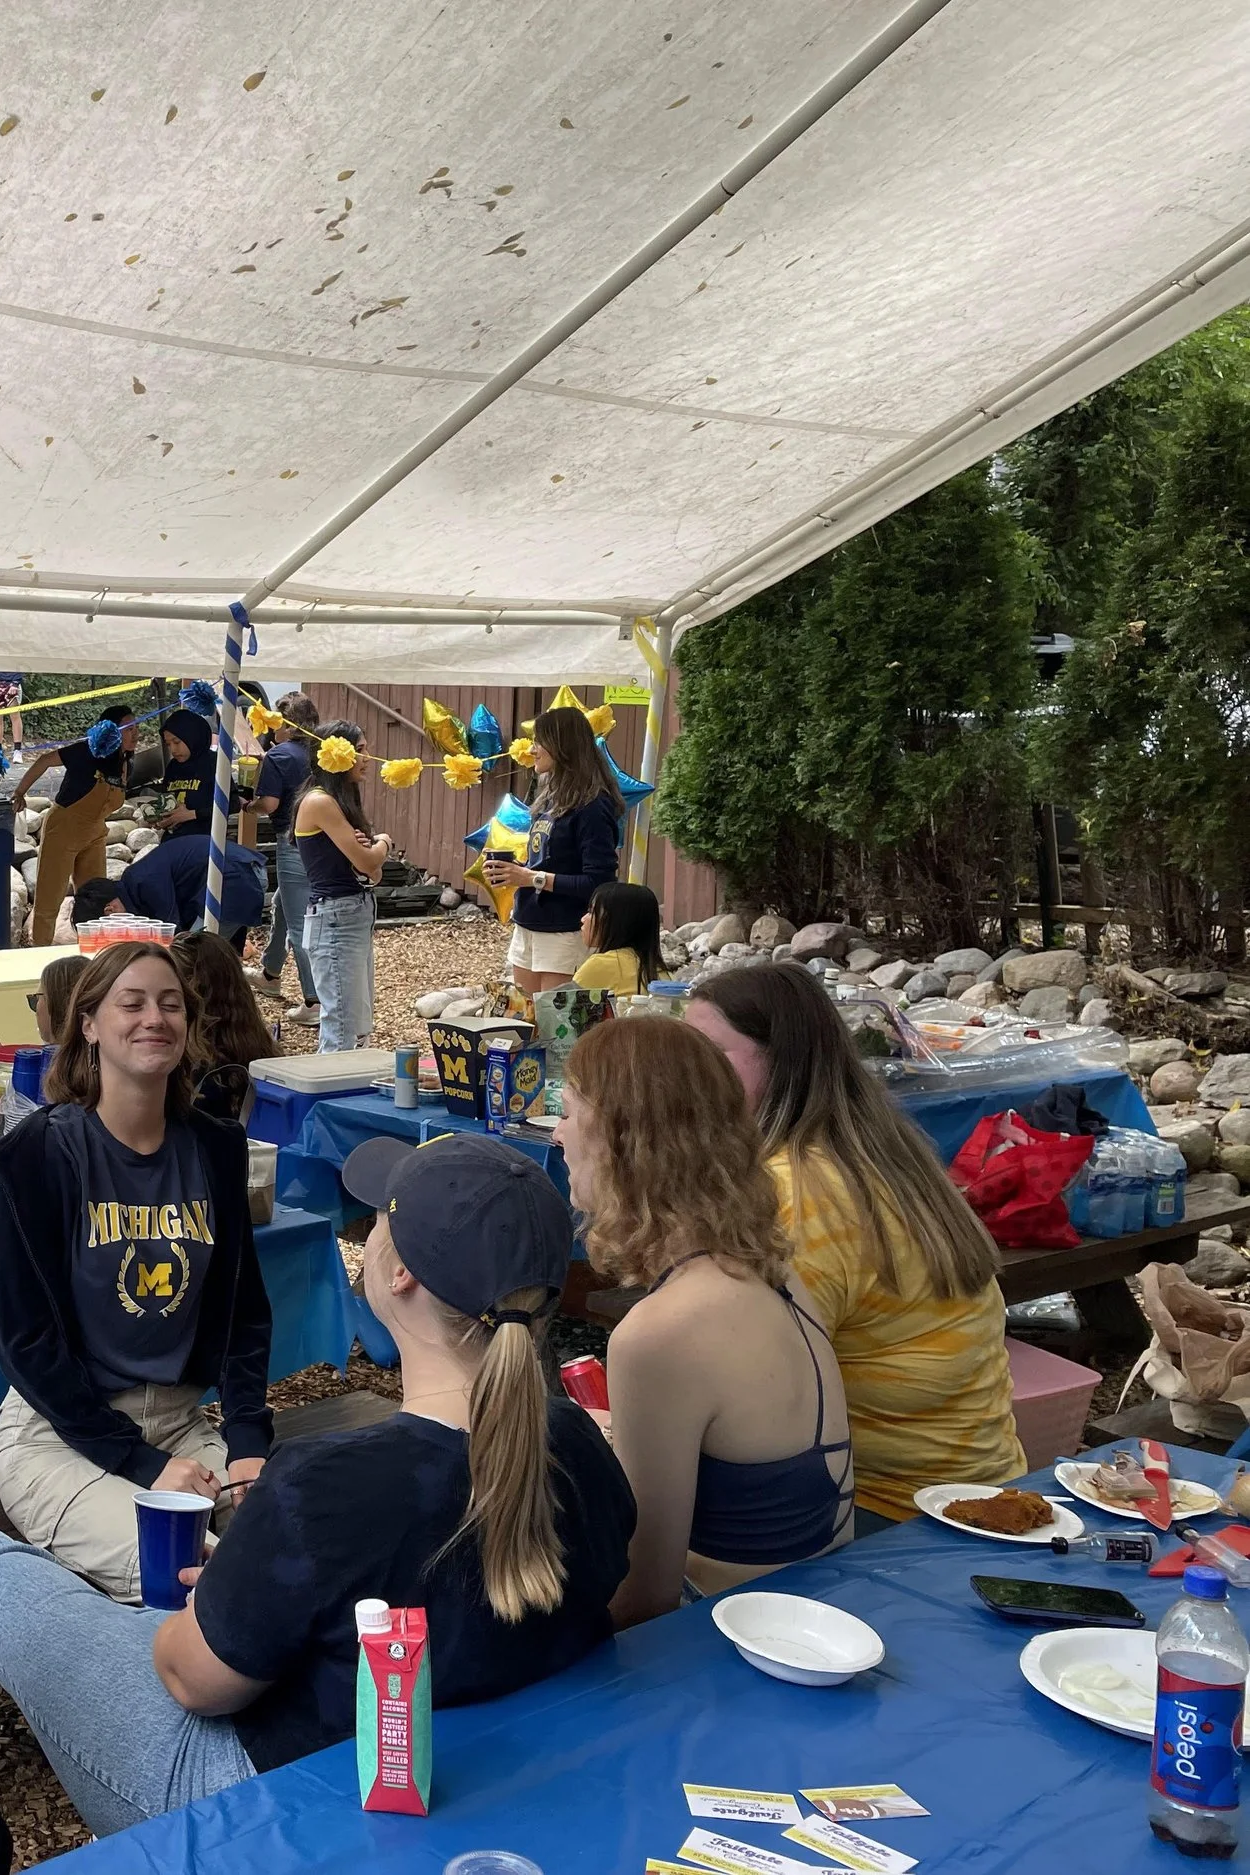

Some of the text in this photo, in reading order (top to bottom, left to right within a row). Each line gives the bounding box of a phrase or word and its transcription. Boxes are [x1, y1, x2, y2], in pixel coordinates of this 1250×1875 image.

[441, 1053, 470, 1084] M
[443, 1086, 474, 1101] POPCORN
[88, 1200, 215, 1248] MICHIGAN
[136, 1262, 173, 1297] M
[382, 1729, 408, 1739] PARTY
[382, 1737, 408, 1746] PUNCH
[1174, 1700, 1202, 1780] pepsi
[382, 1755, 409, 1764] CHILLED
[711, 1807, 783, 1820] Tailgate
[710, 1837, 783, 1865] Tailgate
[822, 1825, 892, 1857] Tailgate
